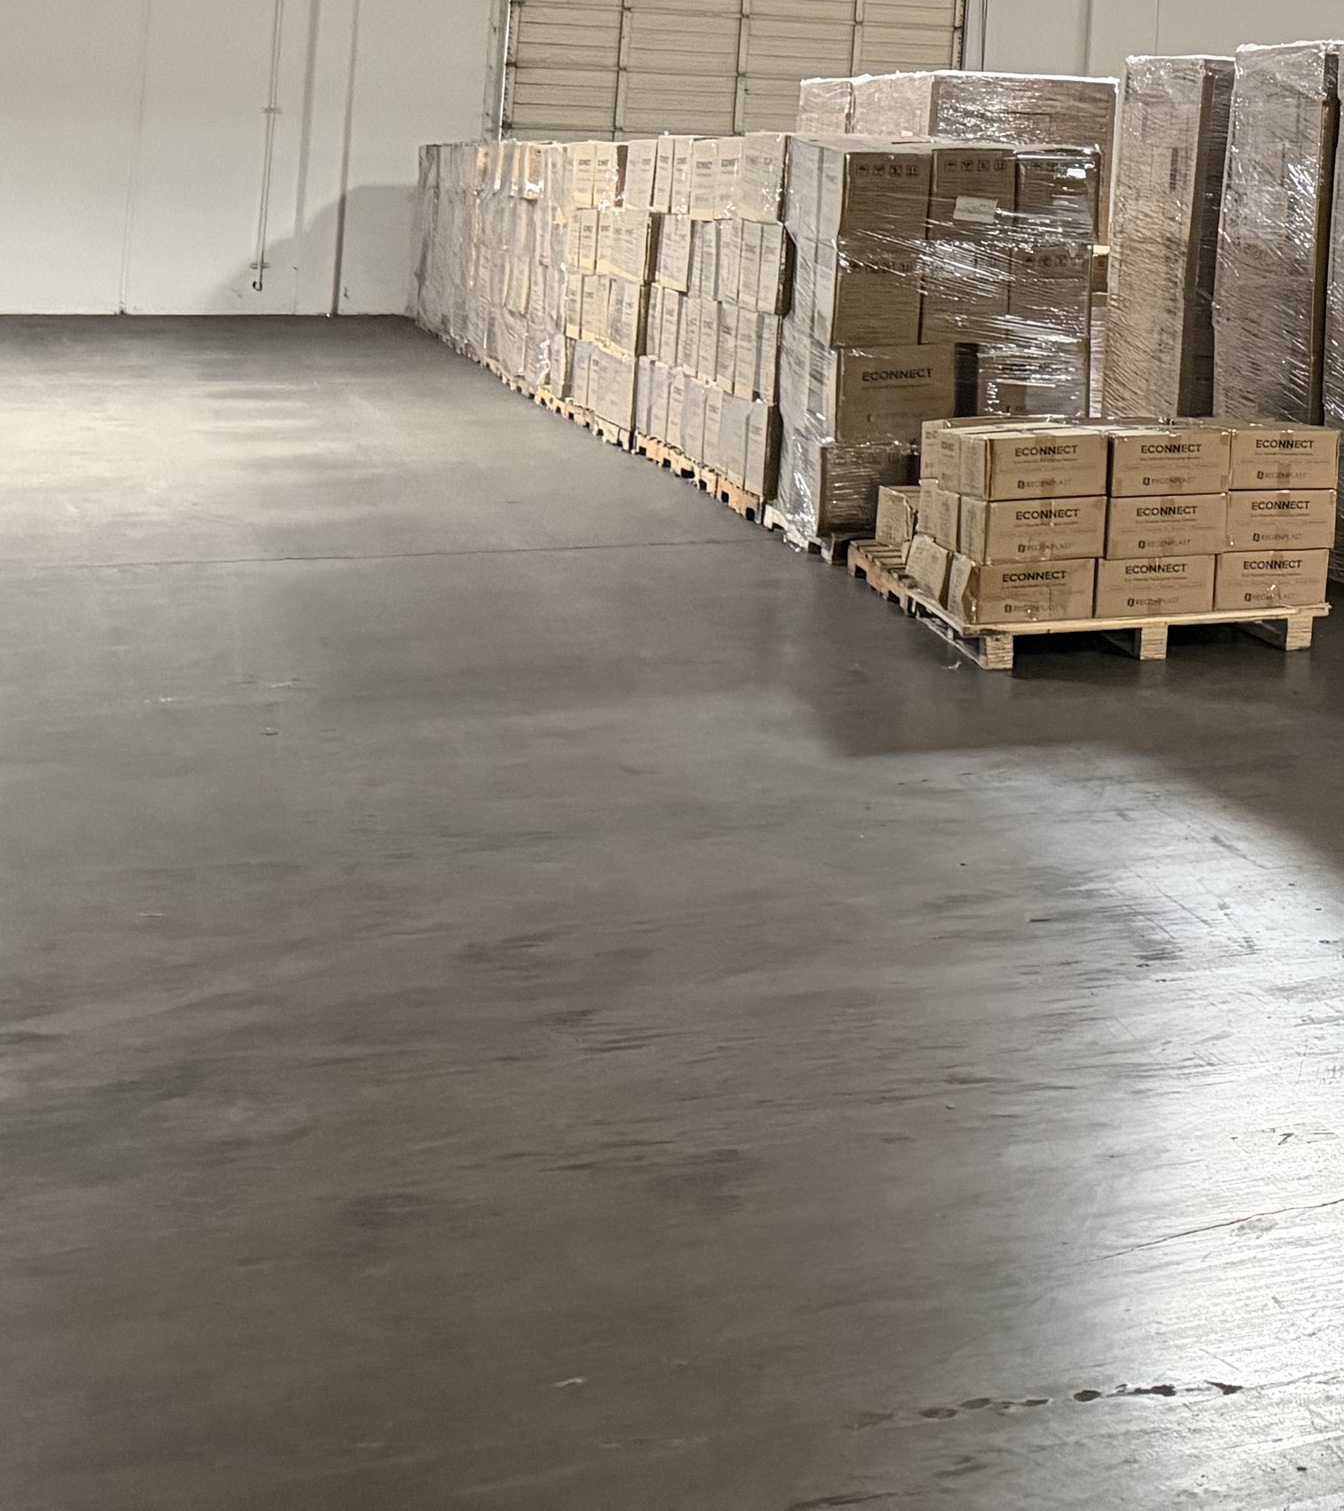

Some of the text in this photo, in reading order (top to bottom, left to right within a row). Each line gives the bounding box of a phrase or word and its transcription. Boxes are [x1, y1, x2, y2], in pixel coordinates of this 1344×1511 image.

[862, 368, 933, 382] ECONNECT
[1141, 444, 1202, 454] ECONNECT
[1256, 440, 1314, 449] ECONNECT
[1015, 445, 1078, 457] ECONNECT
[1252, 501, 1311, 510] ECONNECT
[1016, 509, 1080, 520] ECONNECT
[1136, 506, 1198, 516] ECONNECT
[1125, 564, 1188, 574] ECONNECT
[1243, 560, 1302, 570] ECONNECT
[1002, 571, 1067, 582] ECONNECT
